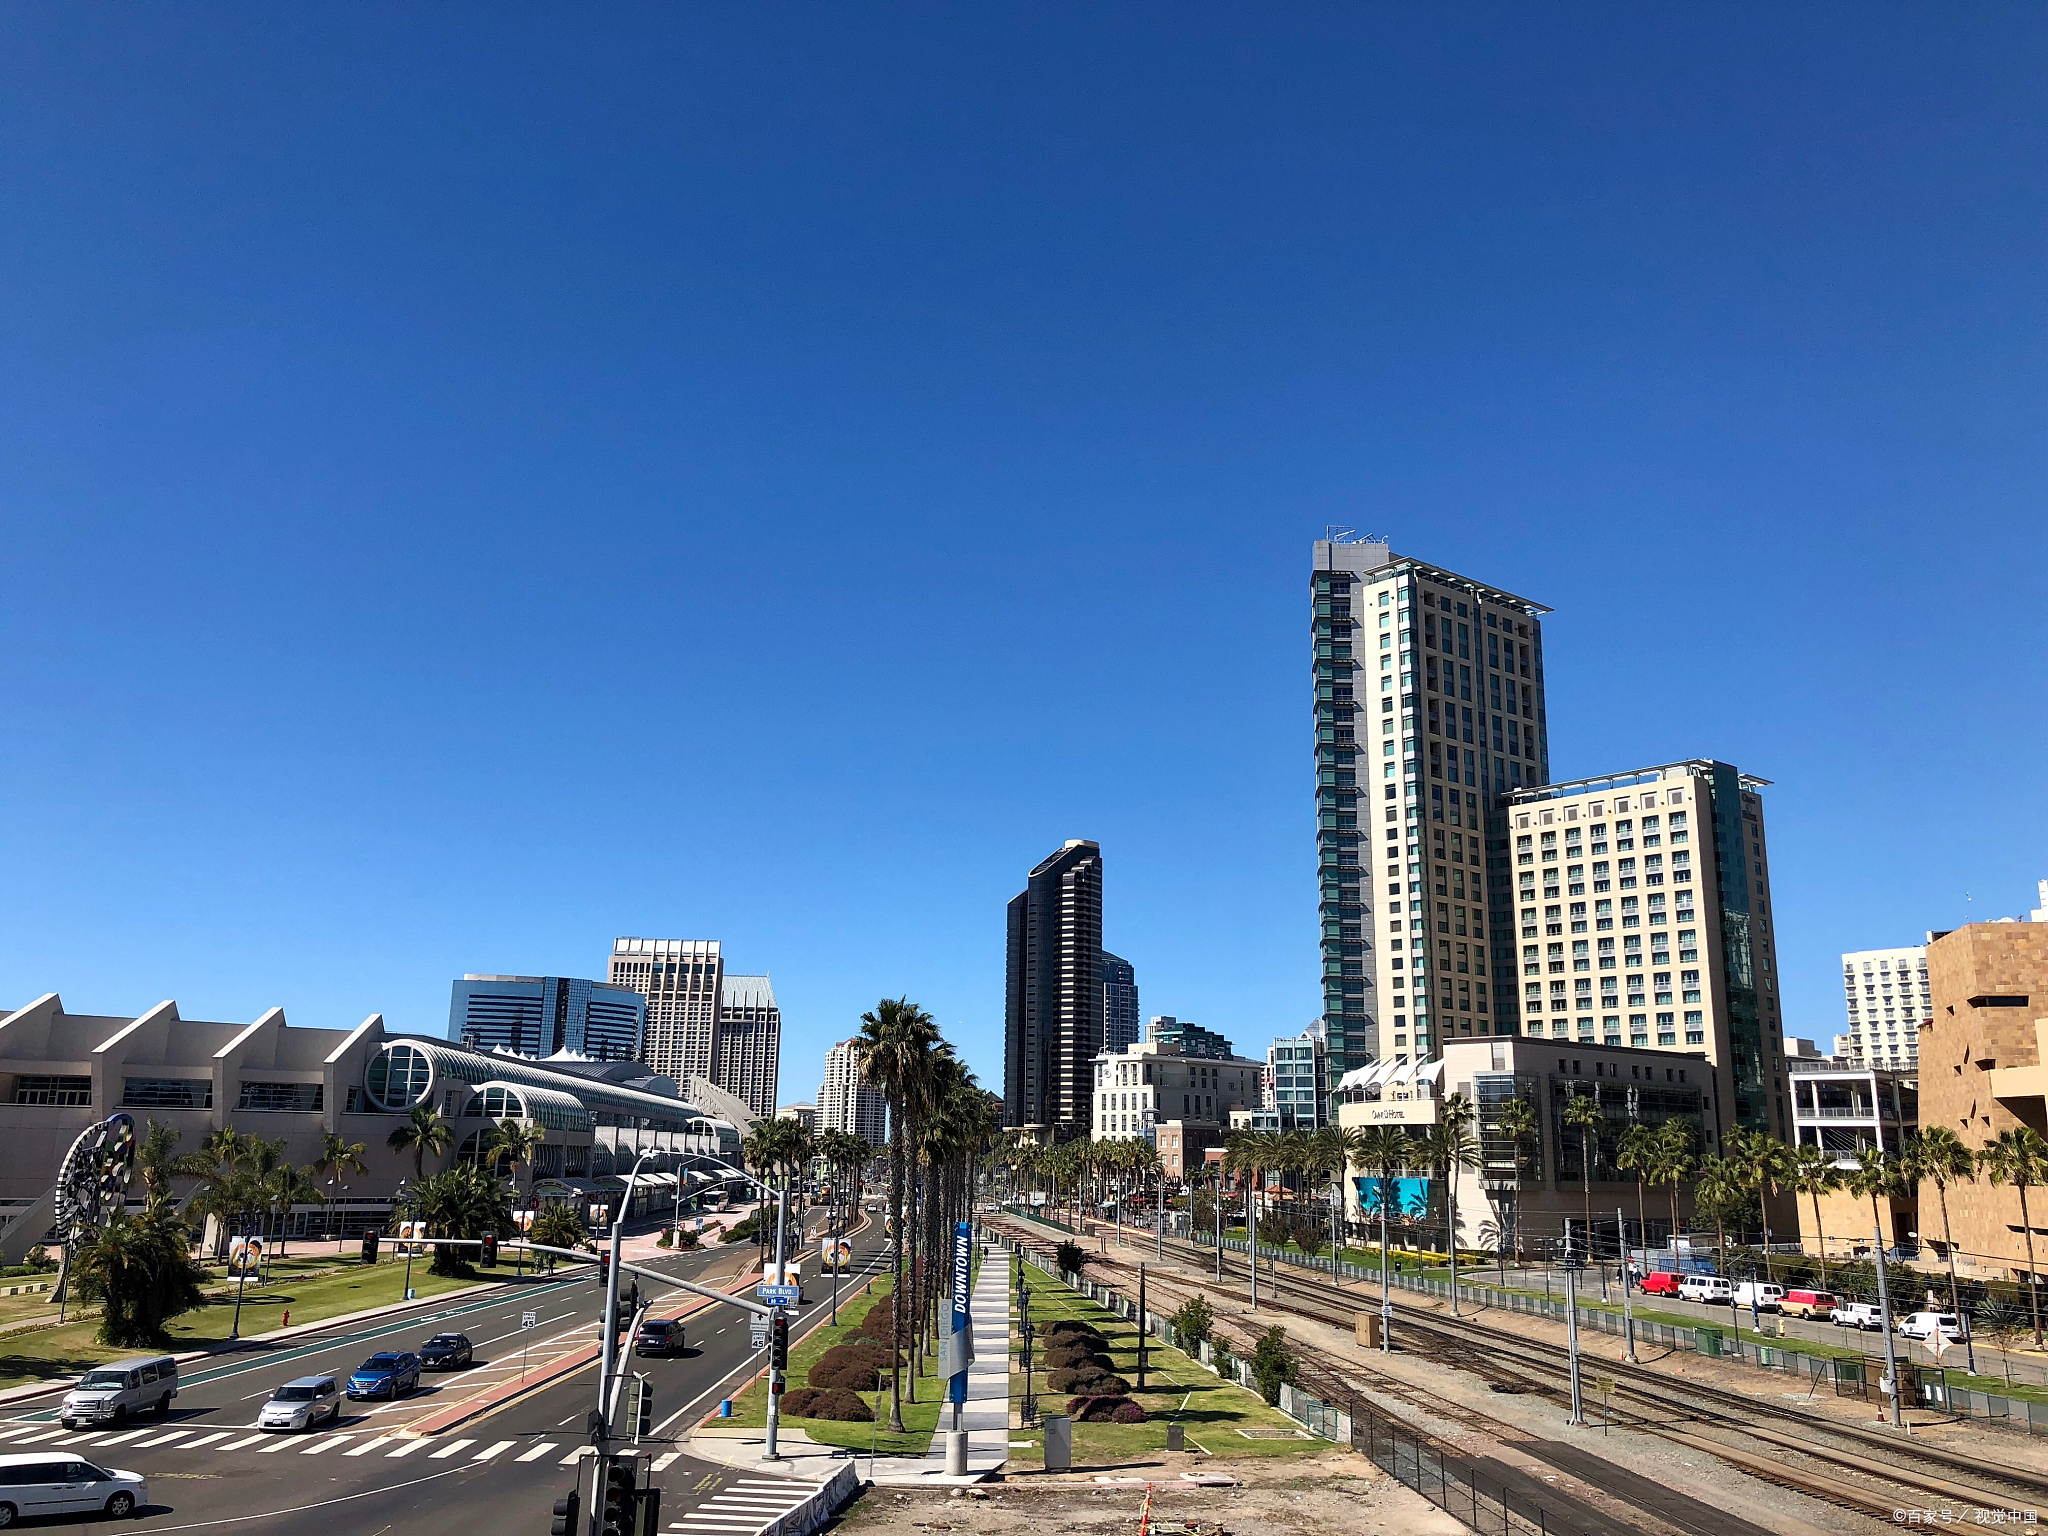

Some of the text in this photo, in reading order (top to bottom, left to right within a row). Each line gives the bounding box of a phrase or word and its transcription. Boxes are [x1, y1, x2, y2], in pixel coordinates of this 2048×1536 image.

[954, 1235, 968, 1314] DOWNTOWN
[940, 1303, 950, 1362] SAN DIEGO
